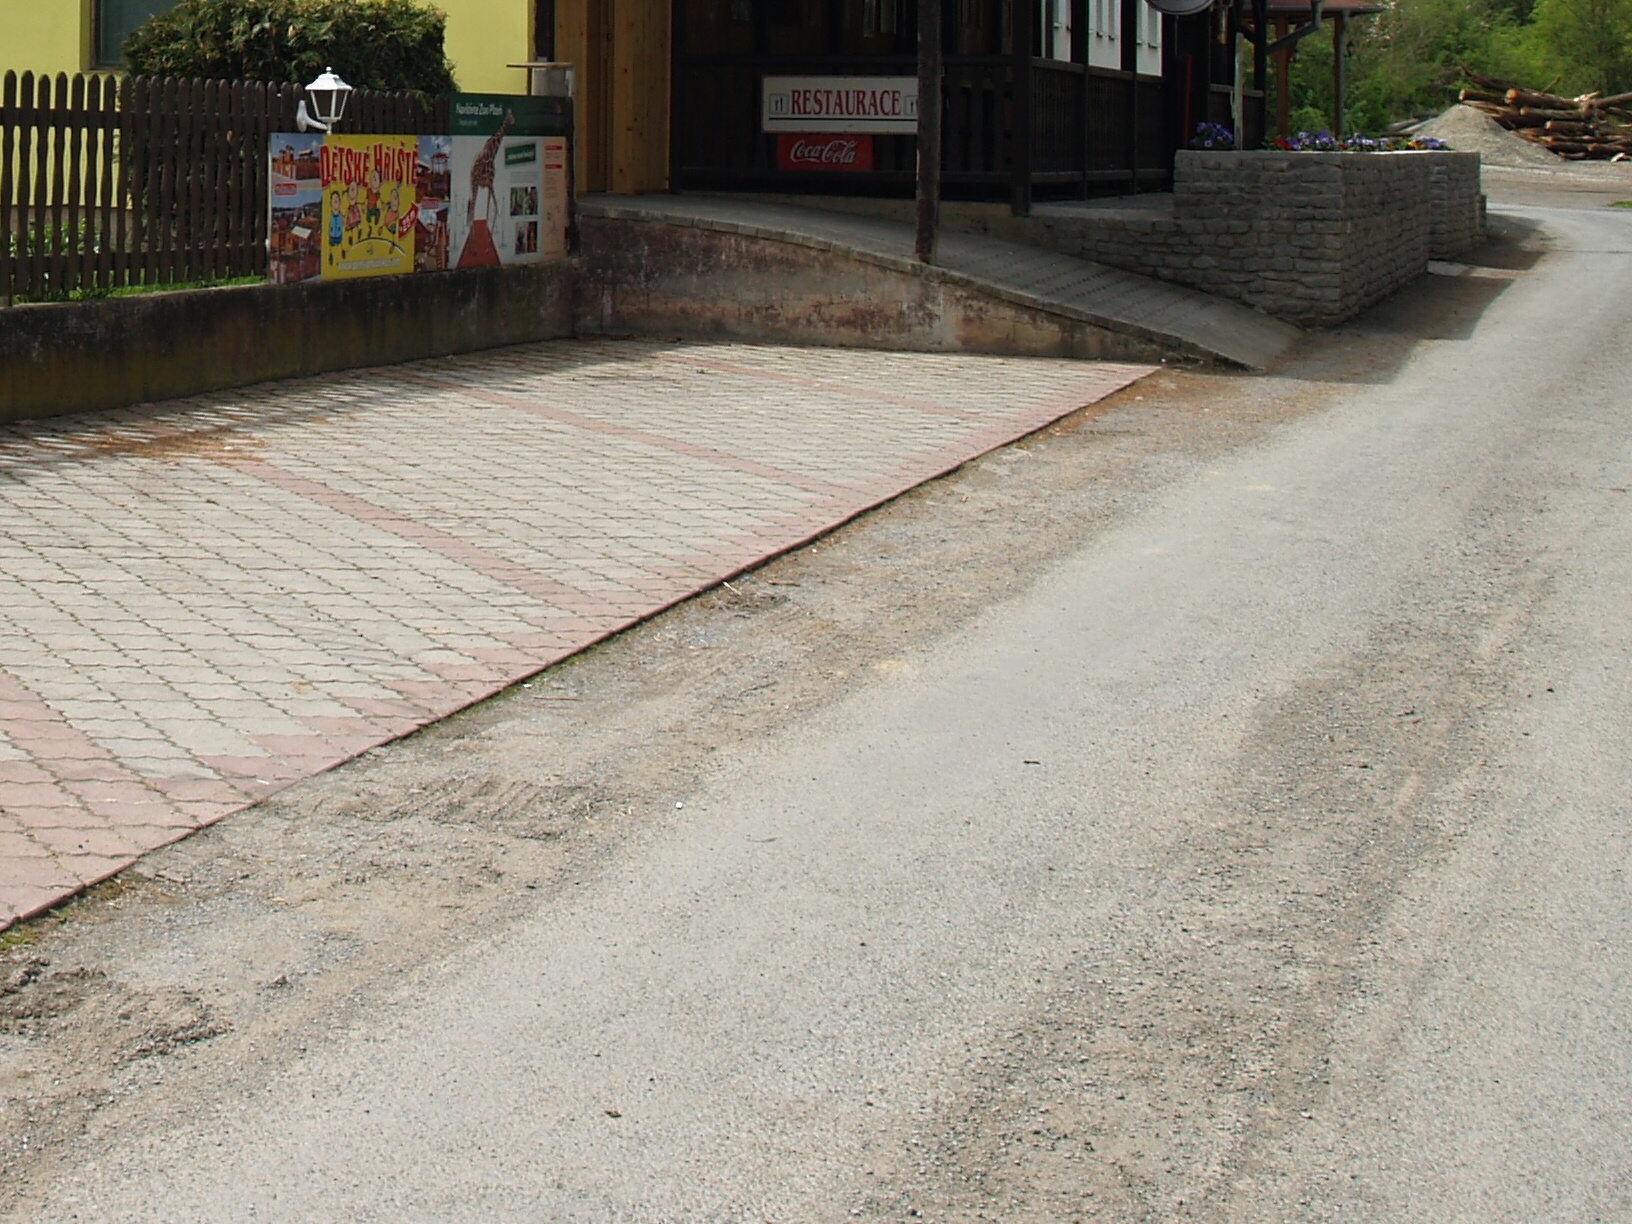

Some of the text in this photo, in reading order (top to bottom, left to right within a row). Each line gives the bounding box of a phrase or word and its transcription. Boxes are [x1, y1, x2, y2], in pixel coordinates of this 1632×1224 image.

[791, 89, 901, 116] RESTAURACE
[319, 140, 419, 189] DĚTSKÉ HŘIŠTĚ
[790, 139, 858, 164] Coca-Cola
